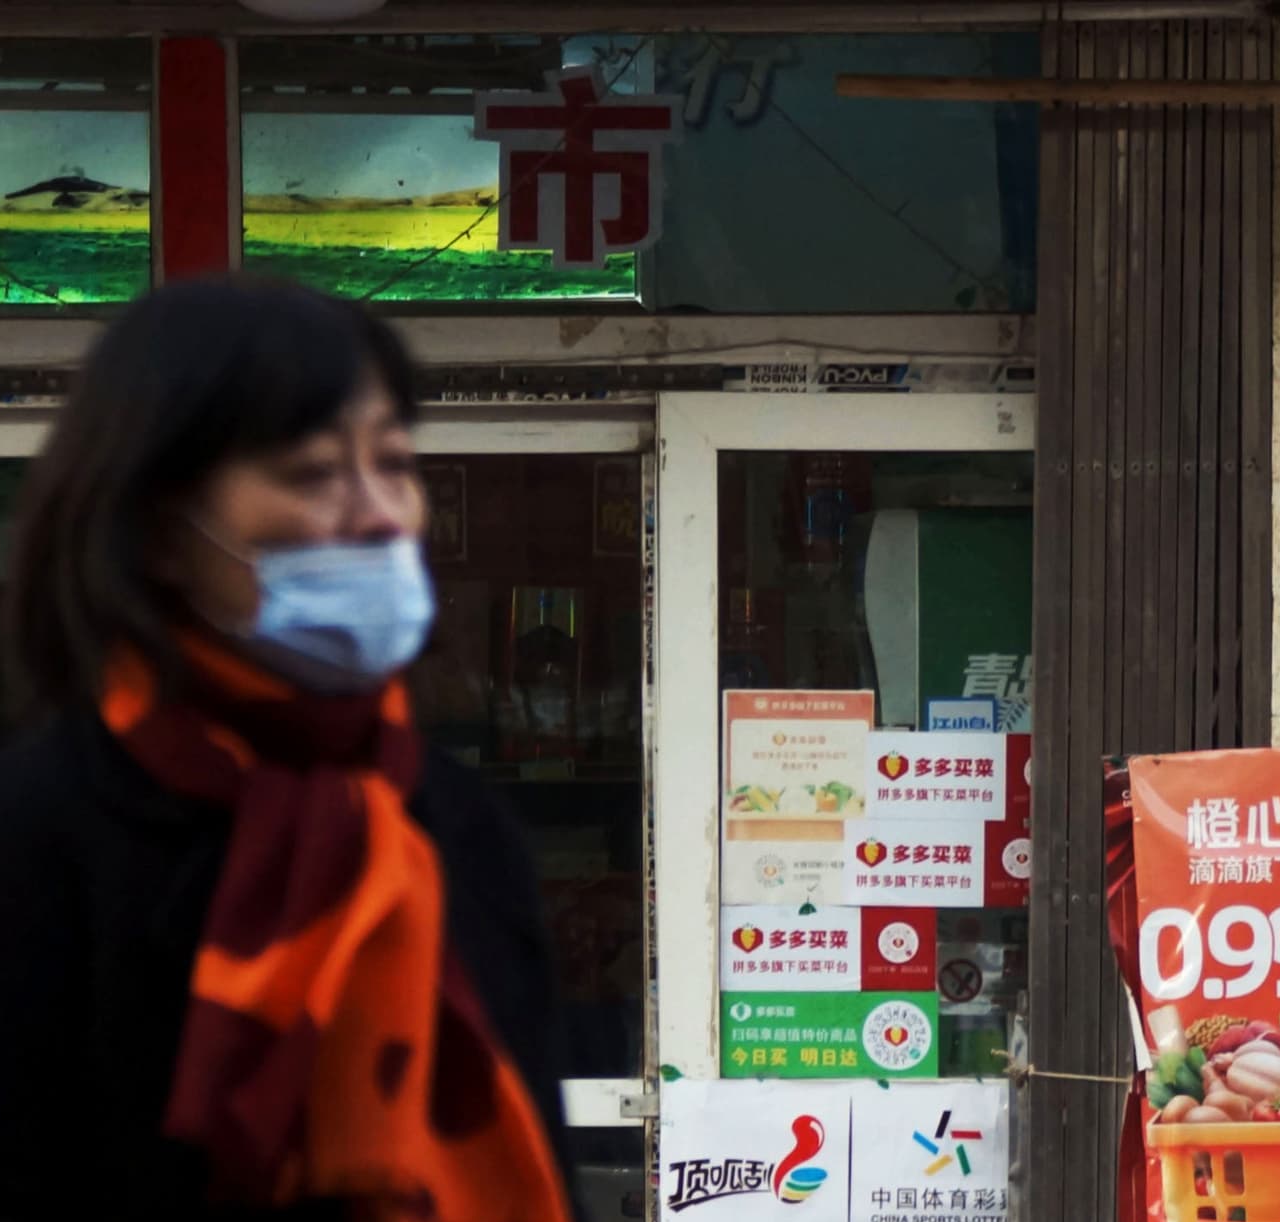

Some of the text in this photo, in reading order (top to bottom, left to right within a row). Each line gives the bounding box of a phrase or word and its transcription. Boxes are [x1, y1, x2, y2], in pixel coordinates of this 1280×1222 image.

[486, 76, 671, 262] 市
[914, 757, 994, 777] 多多买菜
[878, 787, 993, 803] 拼多多旗下买菜平台
[893, 844, 972, 863] 多多买菜
[856, 874, 971, 890] 拼多多旗下买菜平台
[769, 930, 849, 949] 多多买菜
[732, 959, 849, 975] 拼多多旗下买菜平台
[731, 1047, 858, 1067] 今日买 明日达
